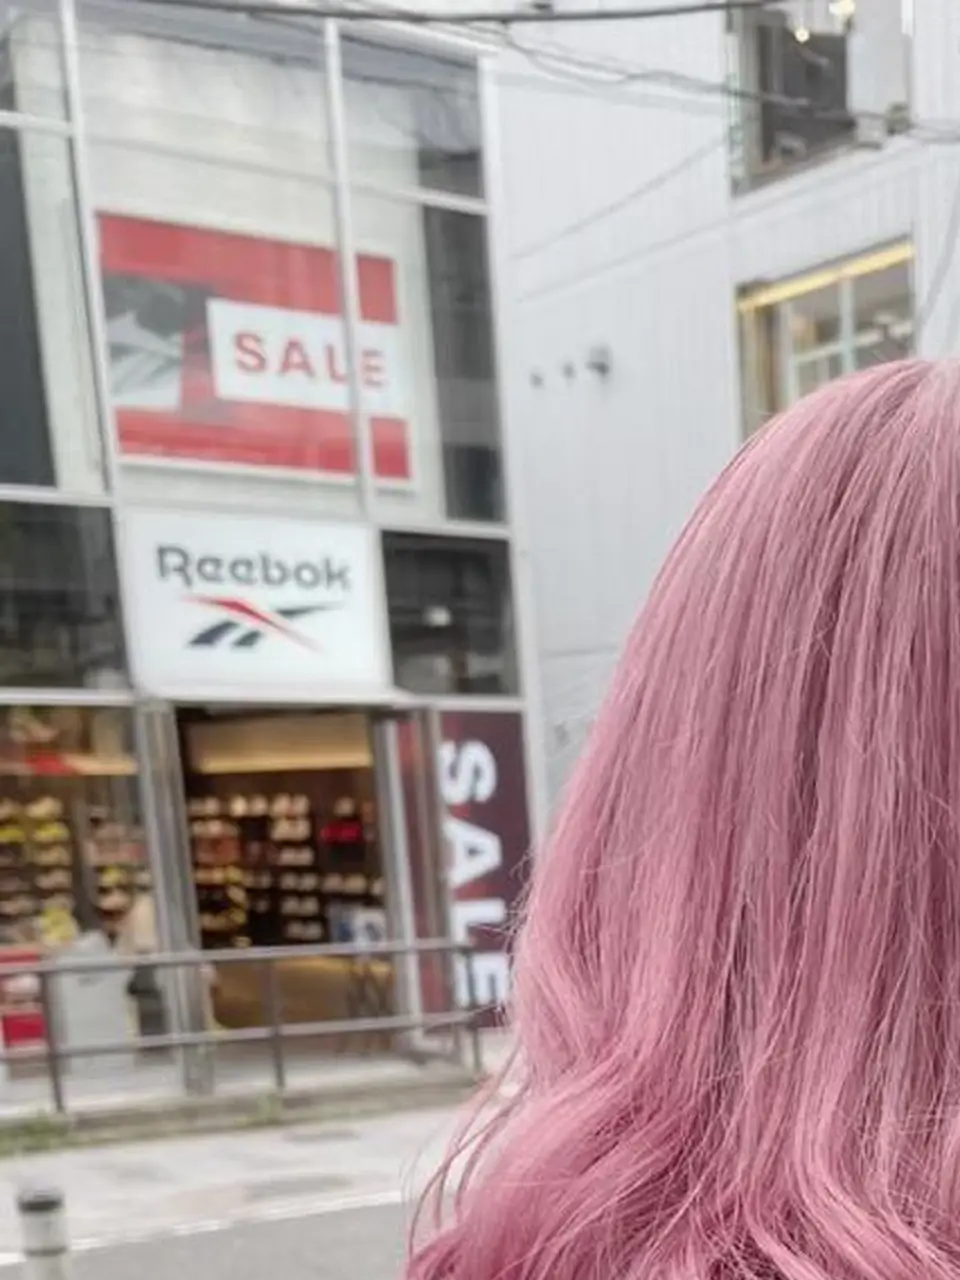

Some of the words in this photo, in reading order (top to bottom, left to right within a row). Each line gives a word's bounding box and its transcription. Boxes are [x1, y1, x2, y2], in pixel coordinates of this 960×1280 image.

[233, 331, 386, 388] SALE
[155, 544, 352, 589] Reebok
[440, 739, 510, 1006] SALE
